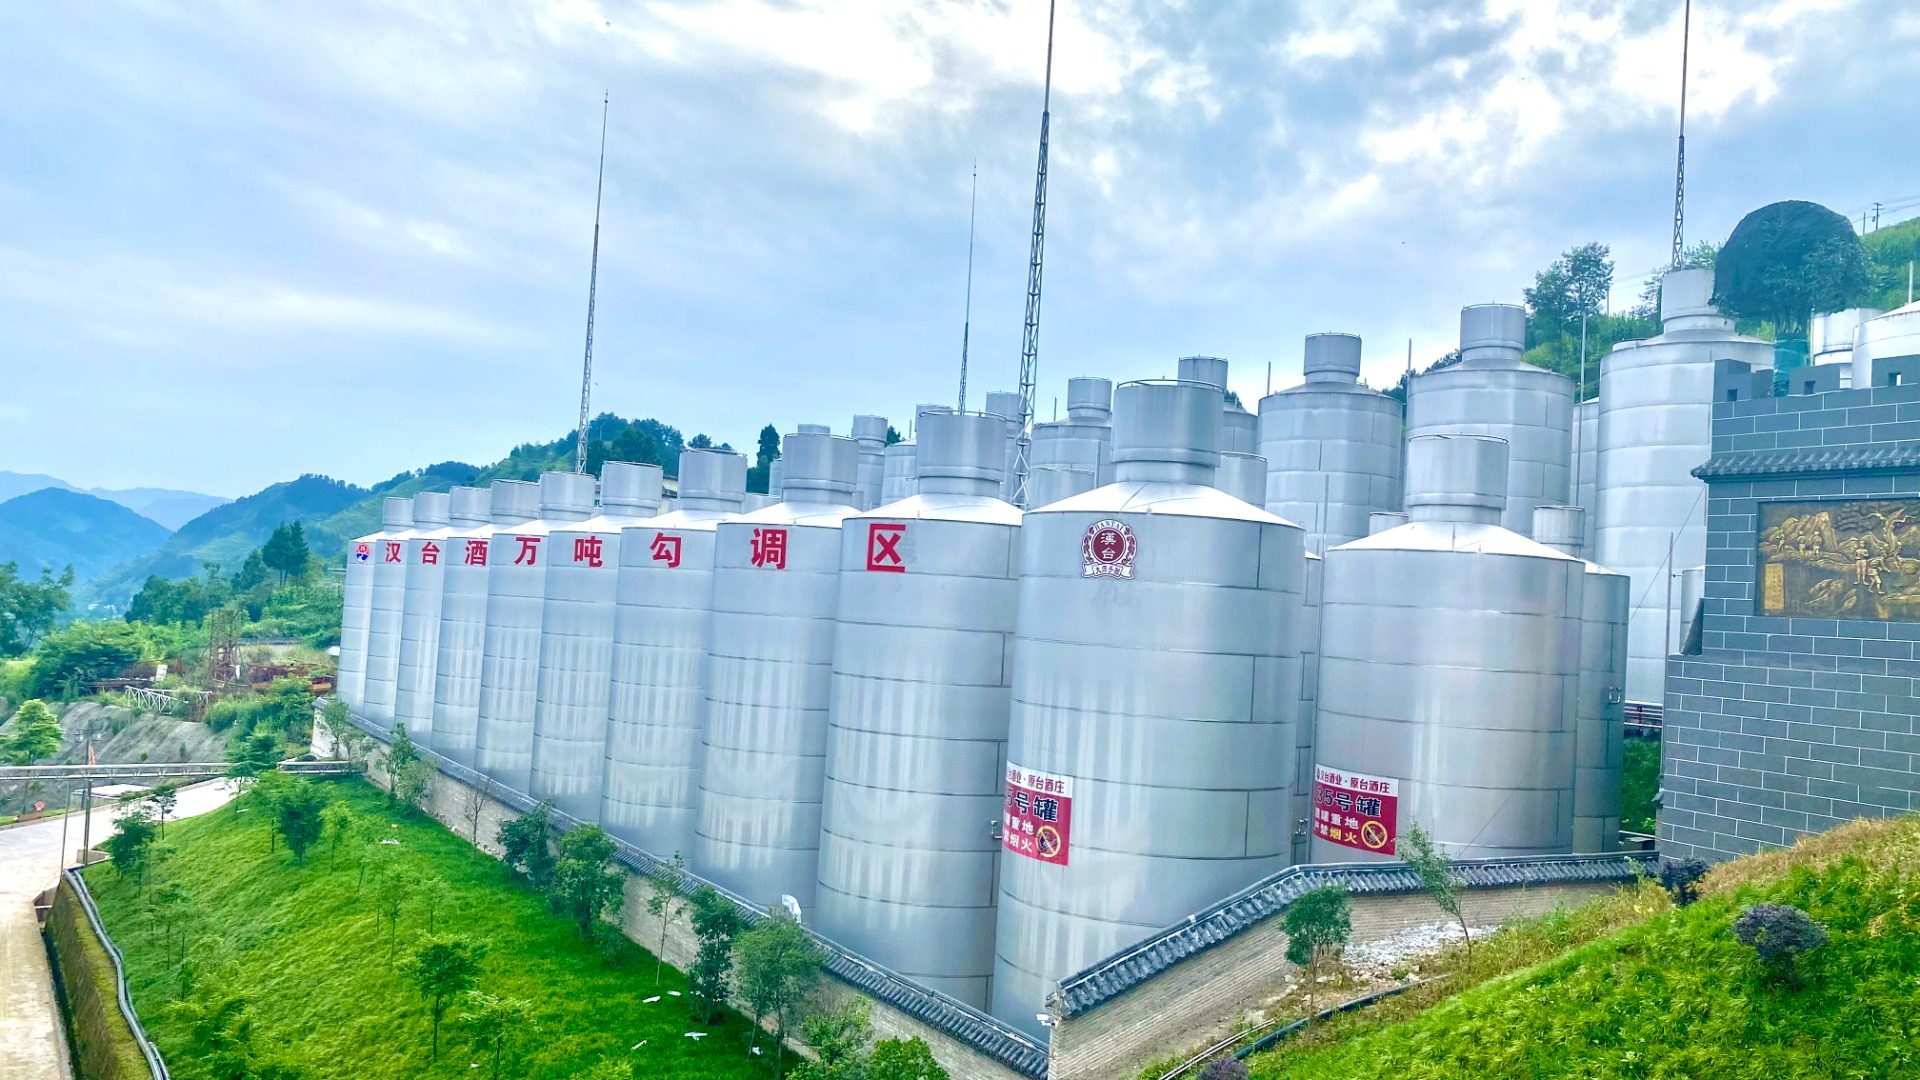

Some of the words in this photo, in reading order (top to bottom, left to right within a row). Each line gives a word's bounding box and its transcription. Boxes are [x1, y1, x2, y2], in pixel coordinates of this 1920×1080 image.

[1095, 521, 1123, 531] HANTAI
[386, 523, 906, 573] 汉台酒万吨勾调区
[1316, 785, 1382, 818] 35号罐
